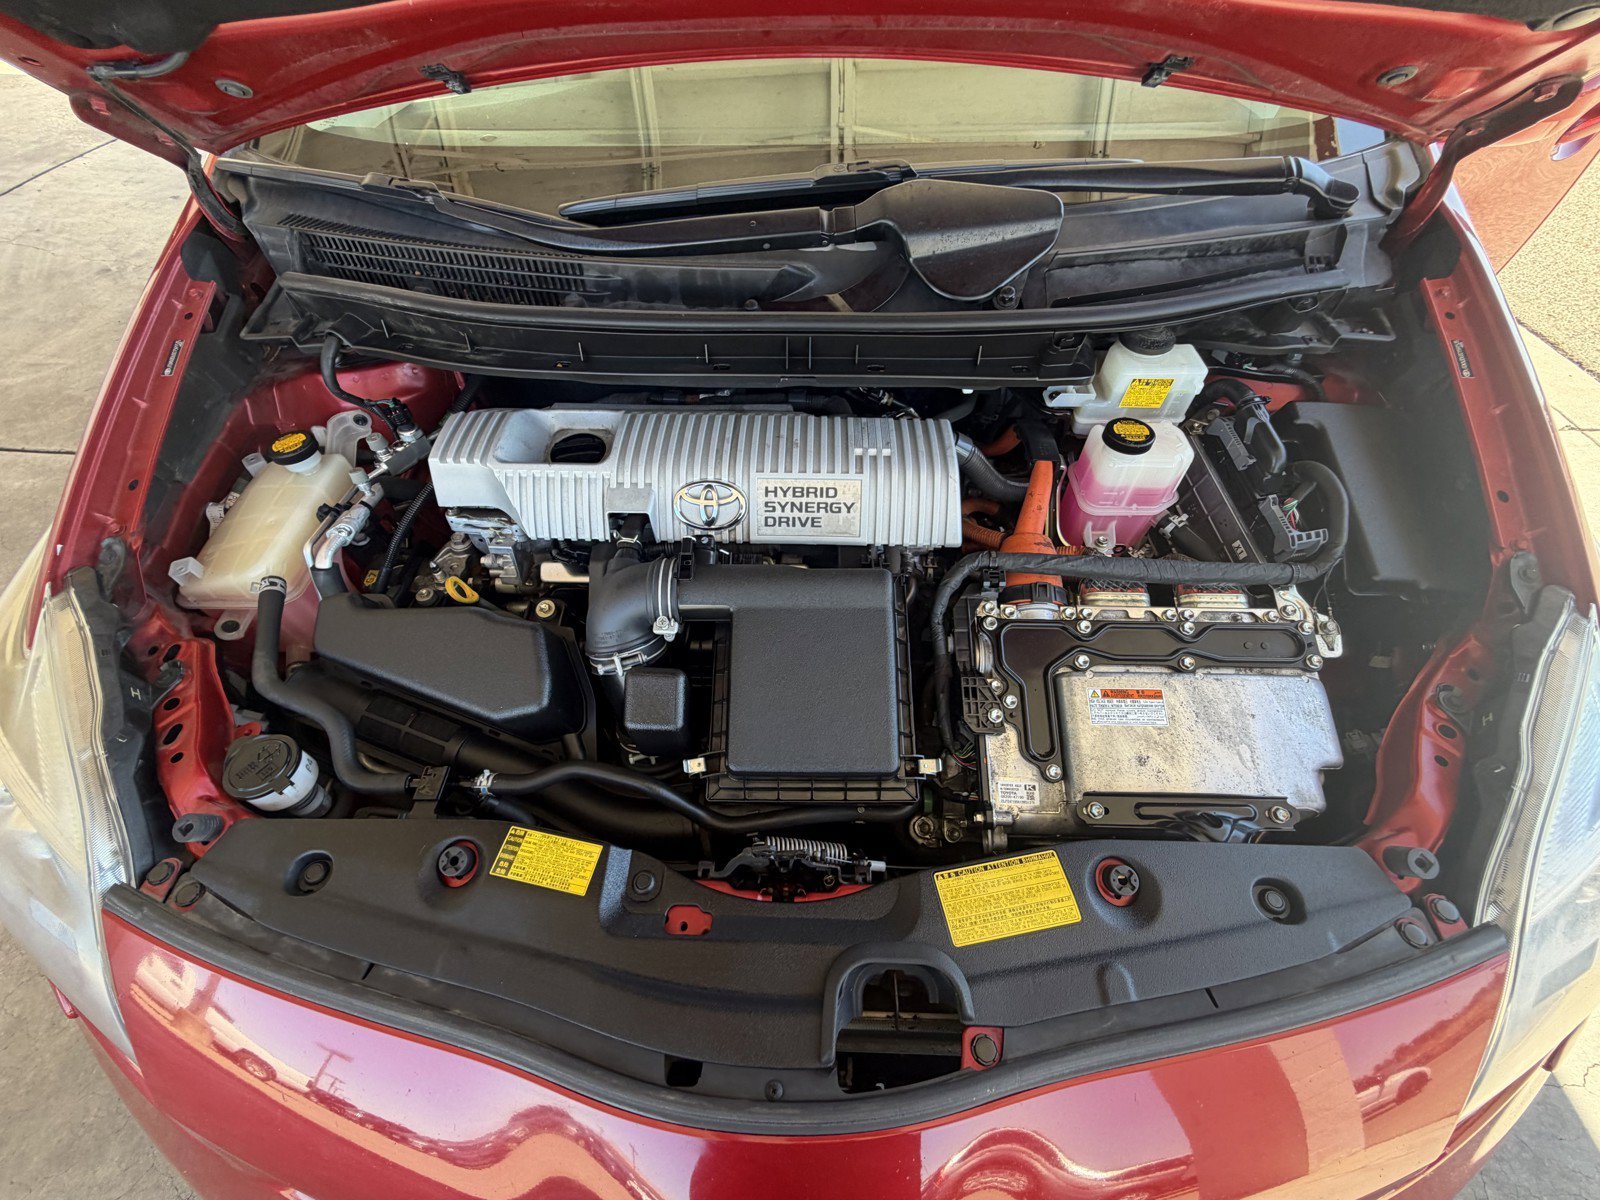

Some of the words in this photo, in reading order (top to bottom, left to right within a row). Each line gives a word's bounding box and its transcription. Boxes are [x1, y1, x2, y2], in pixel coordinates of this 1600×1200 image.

[764, 486, 838, 499] HYBRID
[764, 501, 856, 514] SYNERGY
[764, 516, 822, 528] DRIVE
[957, 865, 985, 876] CAUTION
[988, 858, 1020, 871] ATTENTION
